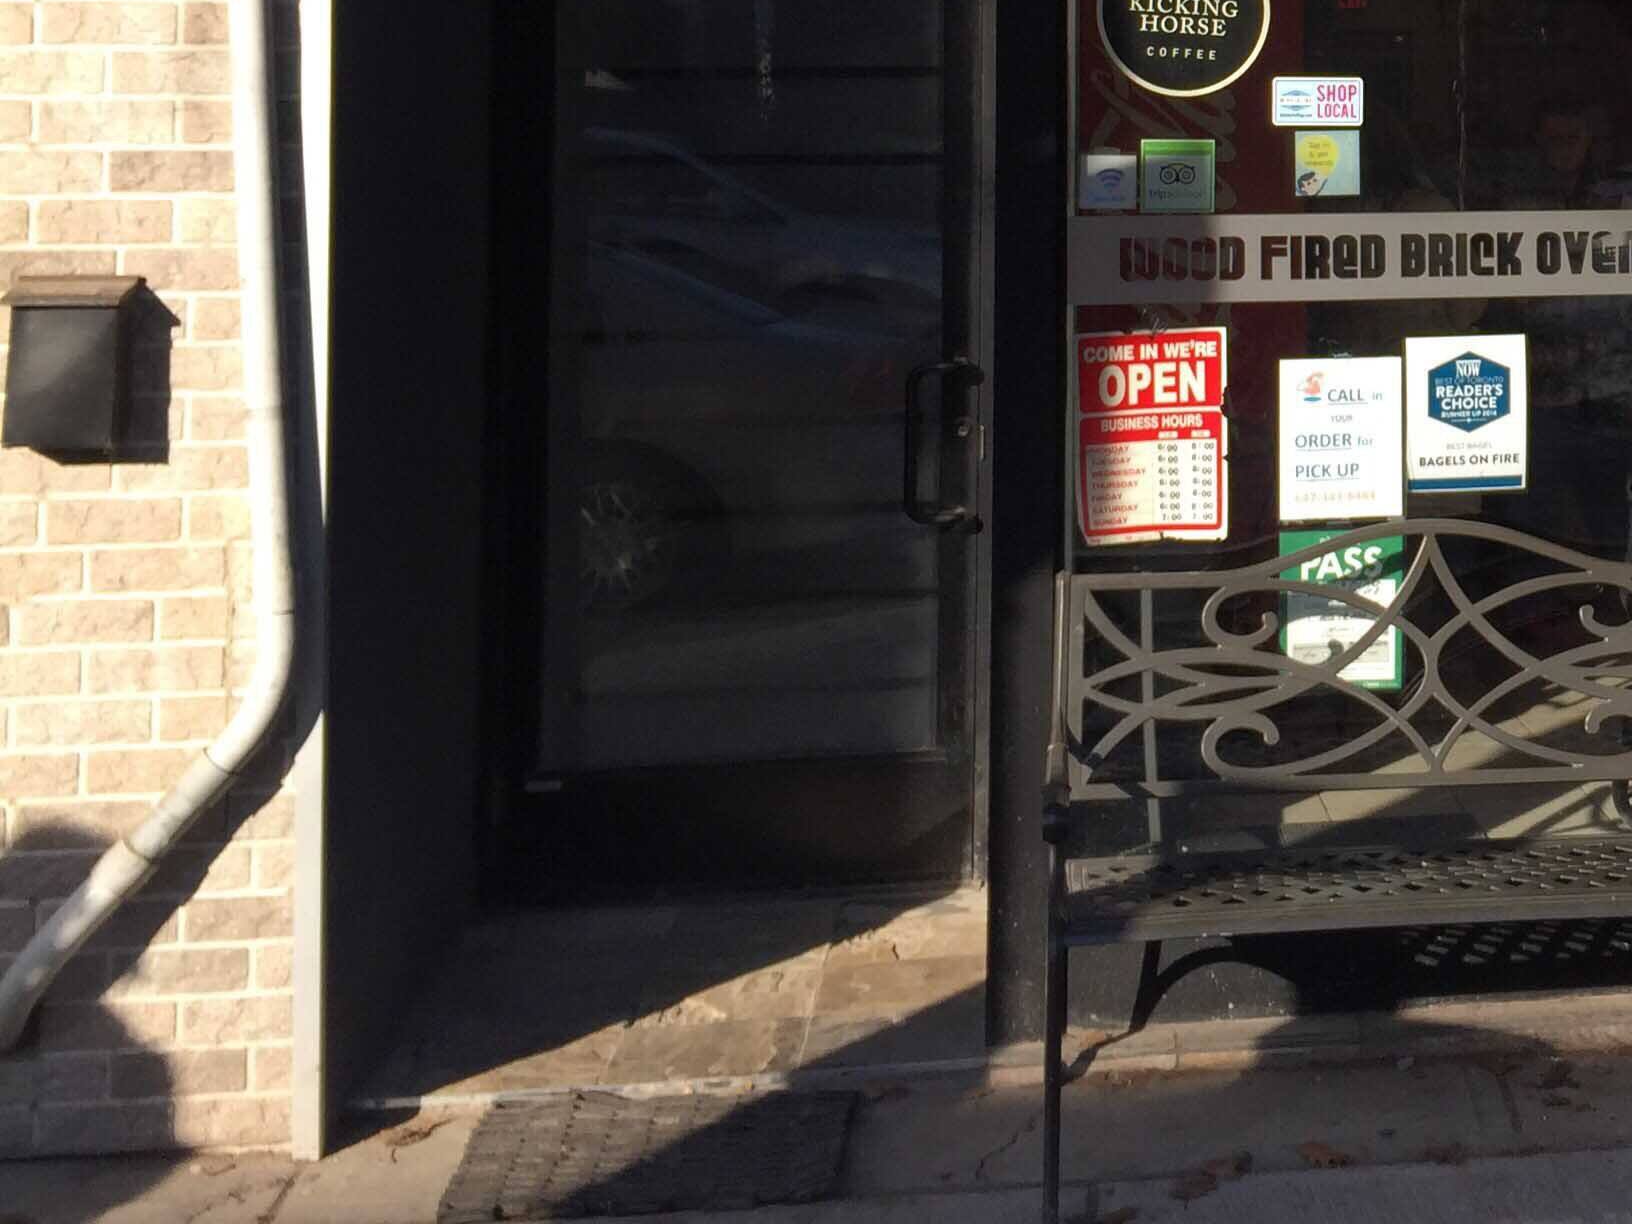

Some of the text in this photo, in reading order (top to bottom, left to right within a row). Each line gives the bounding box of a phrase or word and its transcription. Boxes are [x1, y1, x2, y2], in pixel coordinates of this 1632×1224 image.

[1139, 13, 1228, 37] HORSE
[1146, 45, 1217, 61] COFFEE
[1316, 84, 1358, 103] SHOP
[1316, 103, 1358, 119] LOCAL
[1401, 231, 1524, 278] BRICK
[1083, 339, 1217, 362] COME IN WE'RE
[1455, 359, 1482, 376] NOW
[1098, 360, 1206, 407] OPEN
[1435, 383, 1504, 398] READER'S
[1327, 387, 1365, 403] CALL
[1441, 397, 1497, 410] CHOICE
[1101, 413, 1203, 432] BUSINESS HOURS
[1294, 433, 1352, 449] ORDER
[1419, 453, 1521, 467] BAGELS ON FIRE
[1295, 463, 1360, 478] PICK UP
